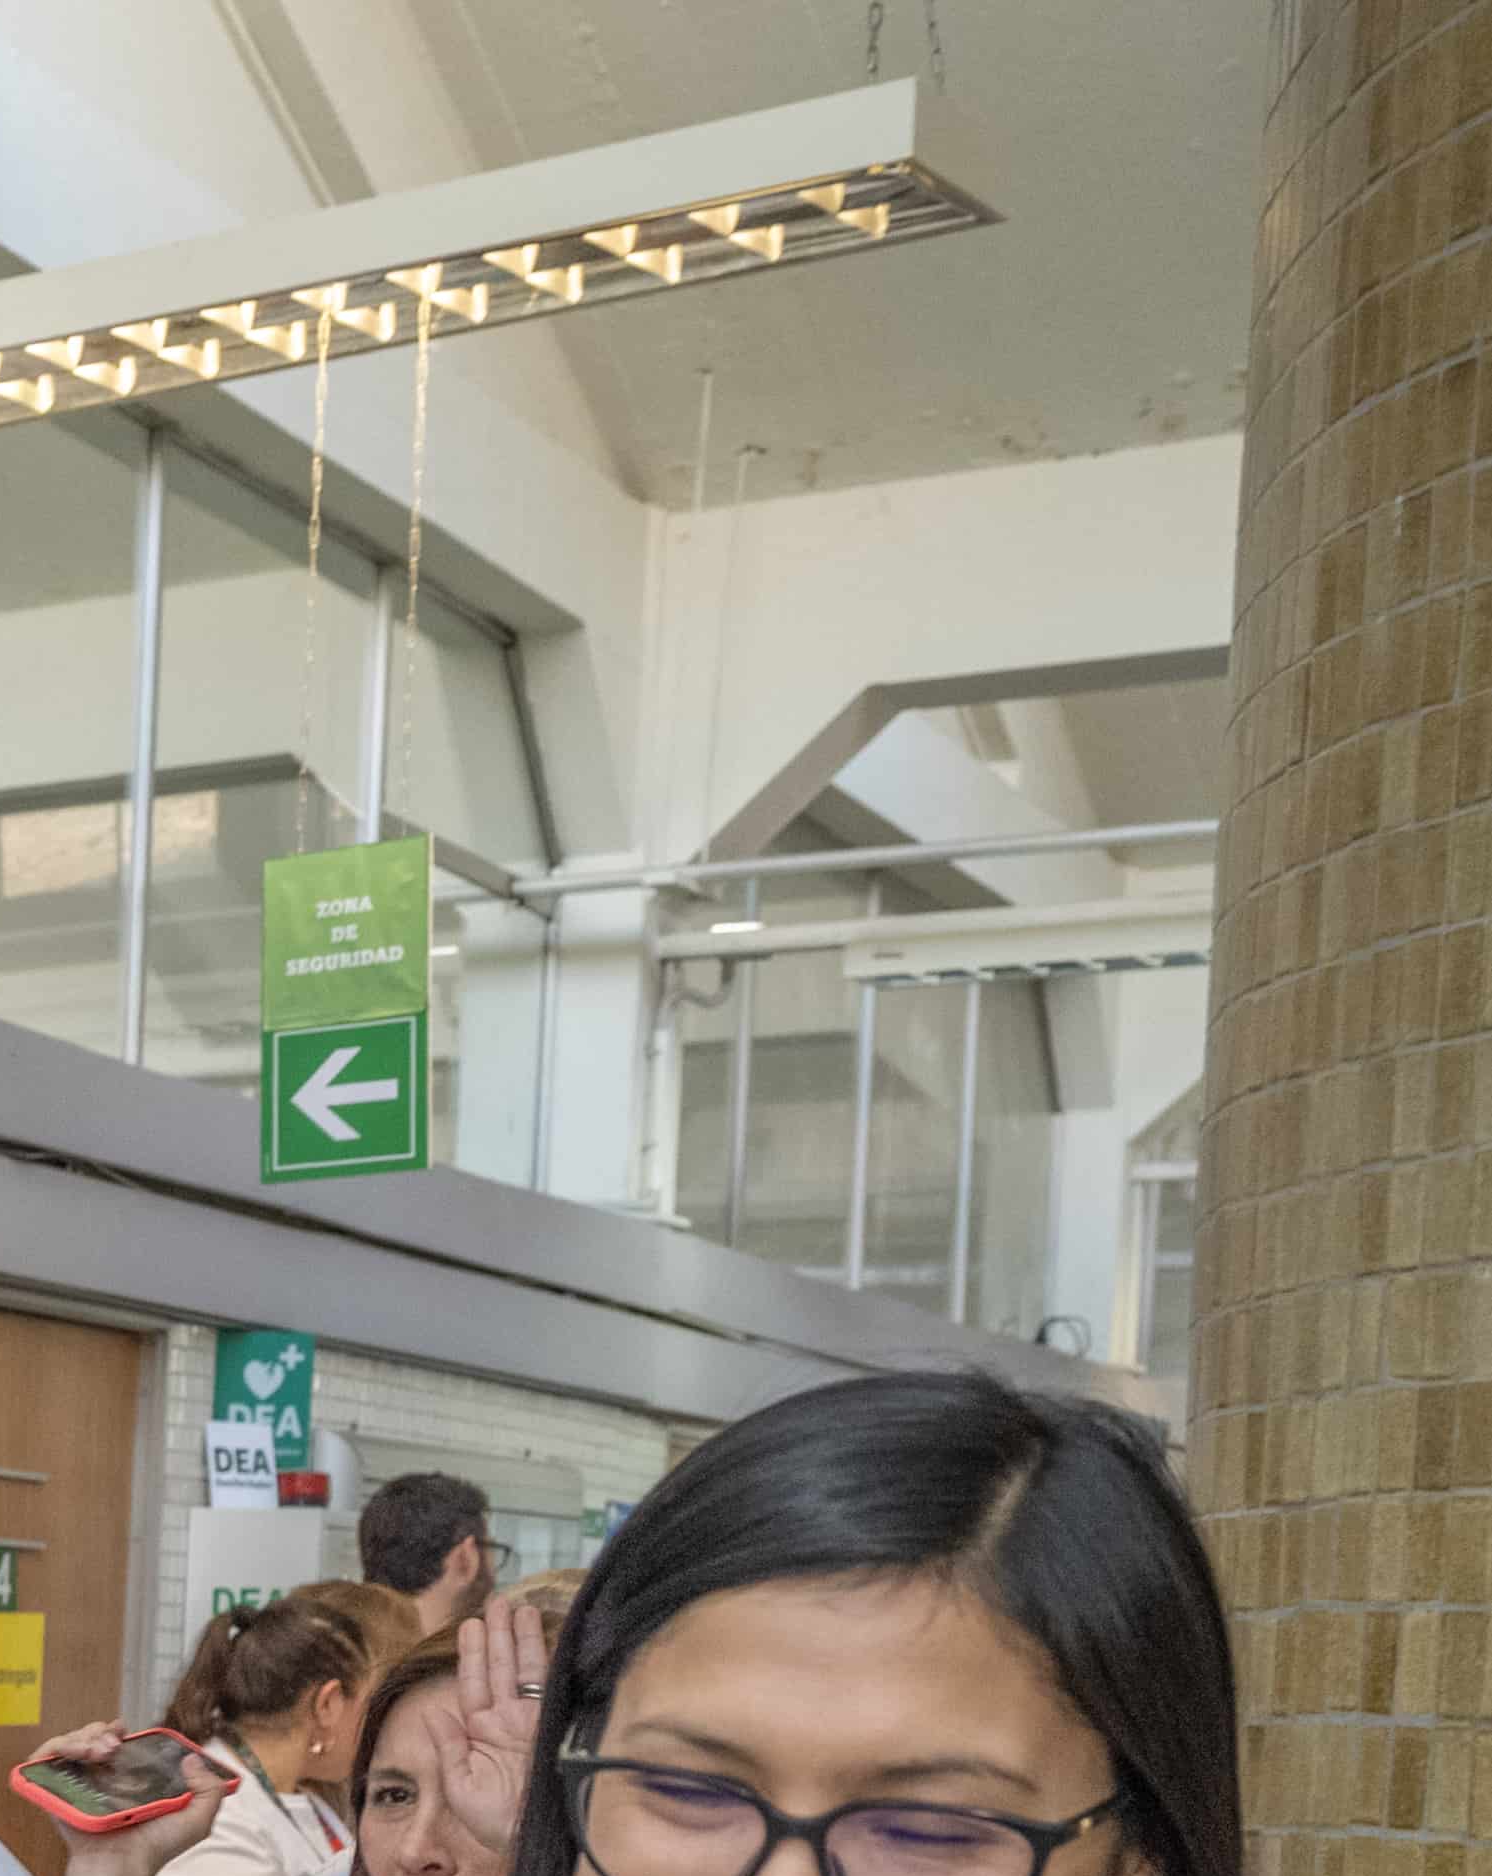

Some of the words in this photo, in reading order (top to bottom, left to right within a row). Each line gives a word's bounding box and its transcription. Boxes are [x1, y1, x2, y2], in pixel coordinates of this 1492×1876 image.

[315, 896, 373, 919] ZONA
[330, 923, 359, 944] DE
[285, 945, 404, 977] SEGURIDAD
[214, 1447, 270, 1475] DEA
